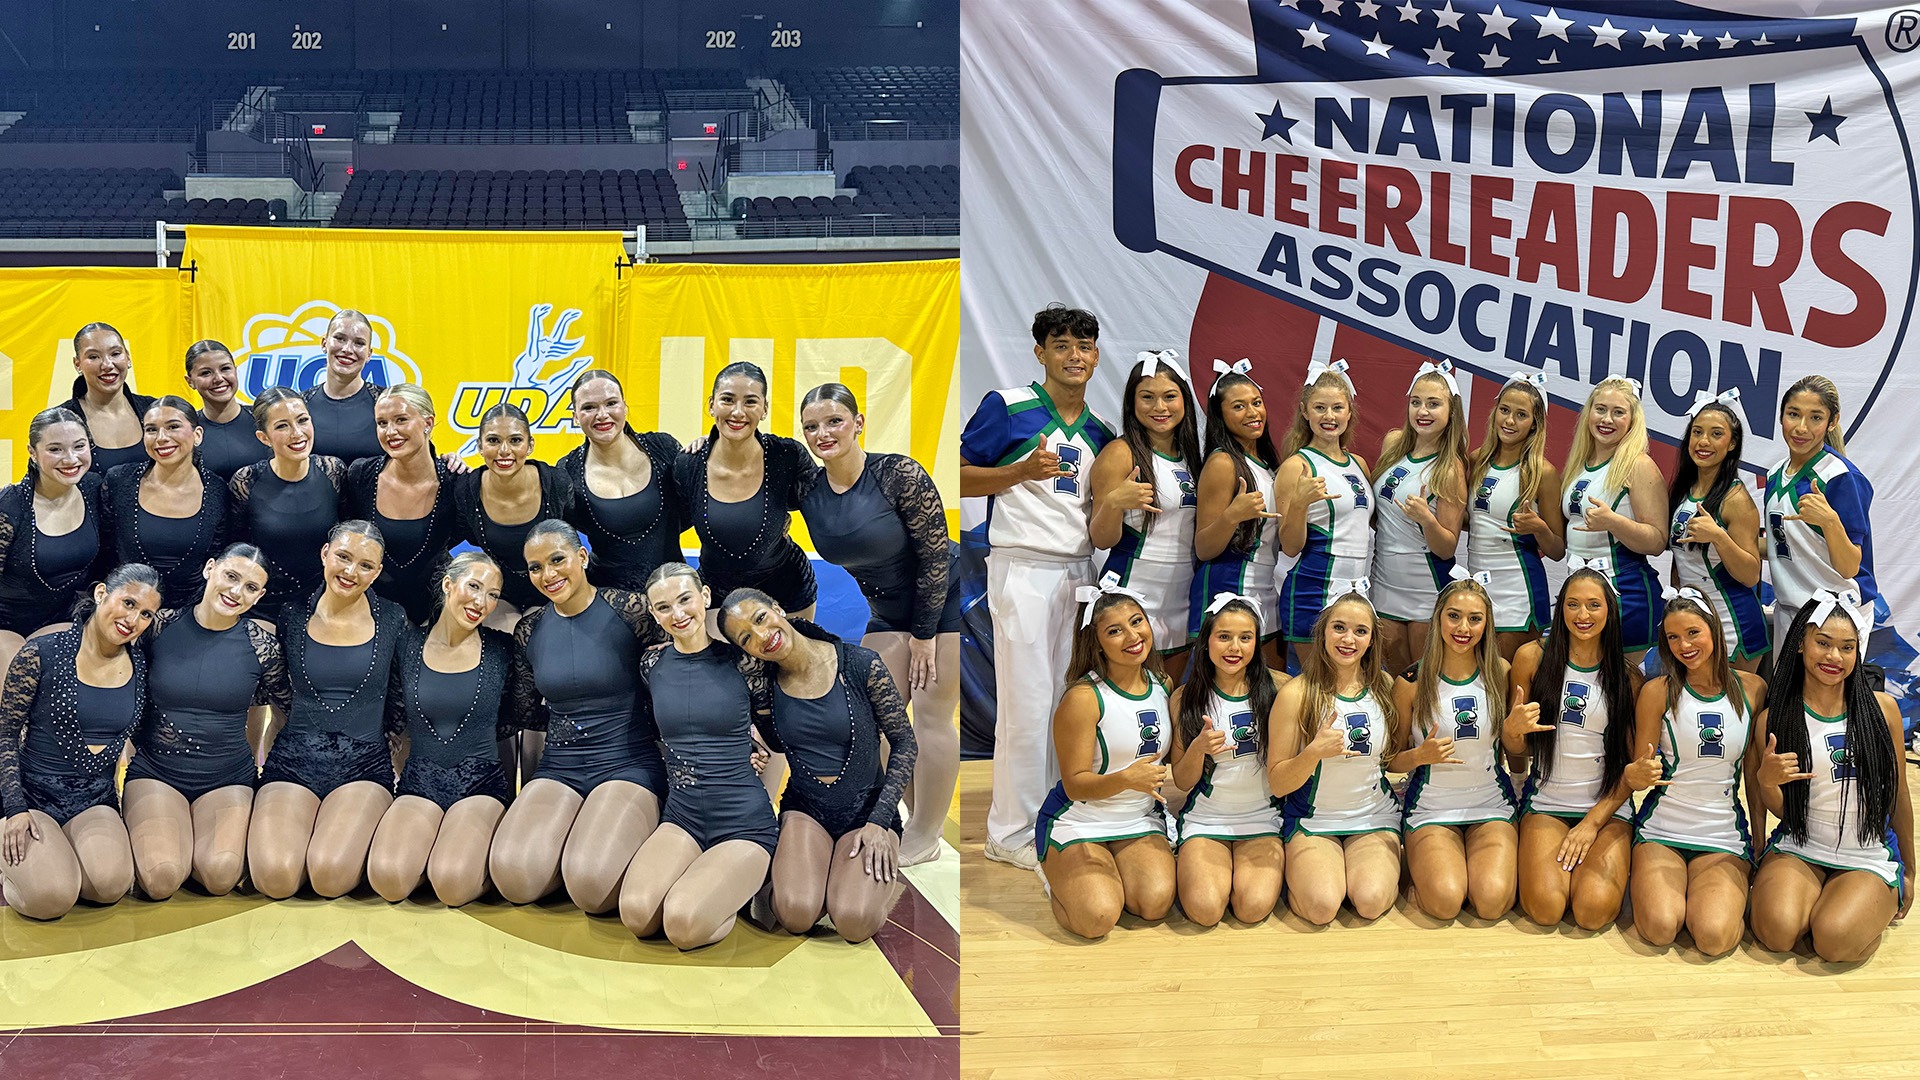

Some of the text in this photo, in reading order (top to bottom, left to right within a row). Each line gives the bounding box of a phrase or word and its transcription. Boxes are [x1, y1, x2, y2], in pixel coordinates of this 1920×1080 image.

[227, 32, 256, 50] 201
[291, 31, 322, 50] 202
[705, 30, 736, 48] 202
[771, 30, 802, 48] 203
[1313, 83, 1795, 186] NATIONAL
[1175, 144, 1892, 348] CHEERLEADERS
[1257, 231, 1783, 441] ASSOCIATION
